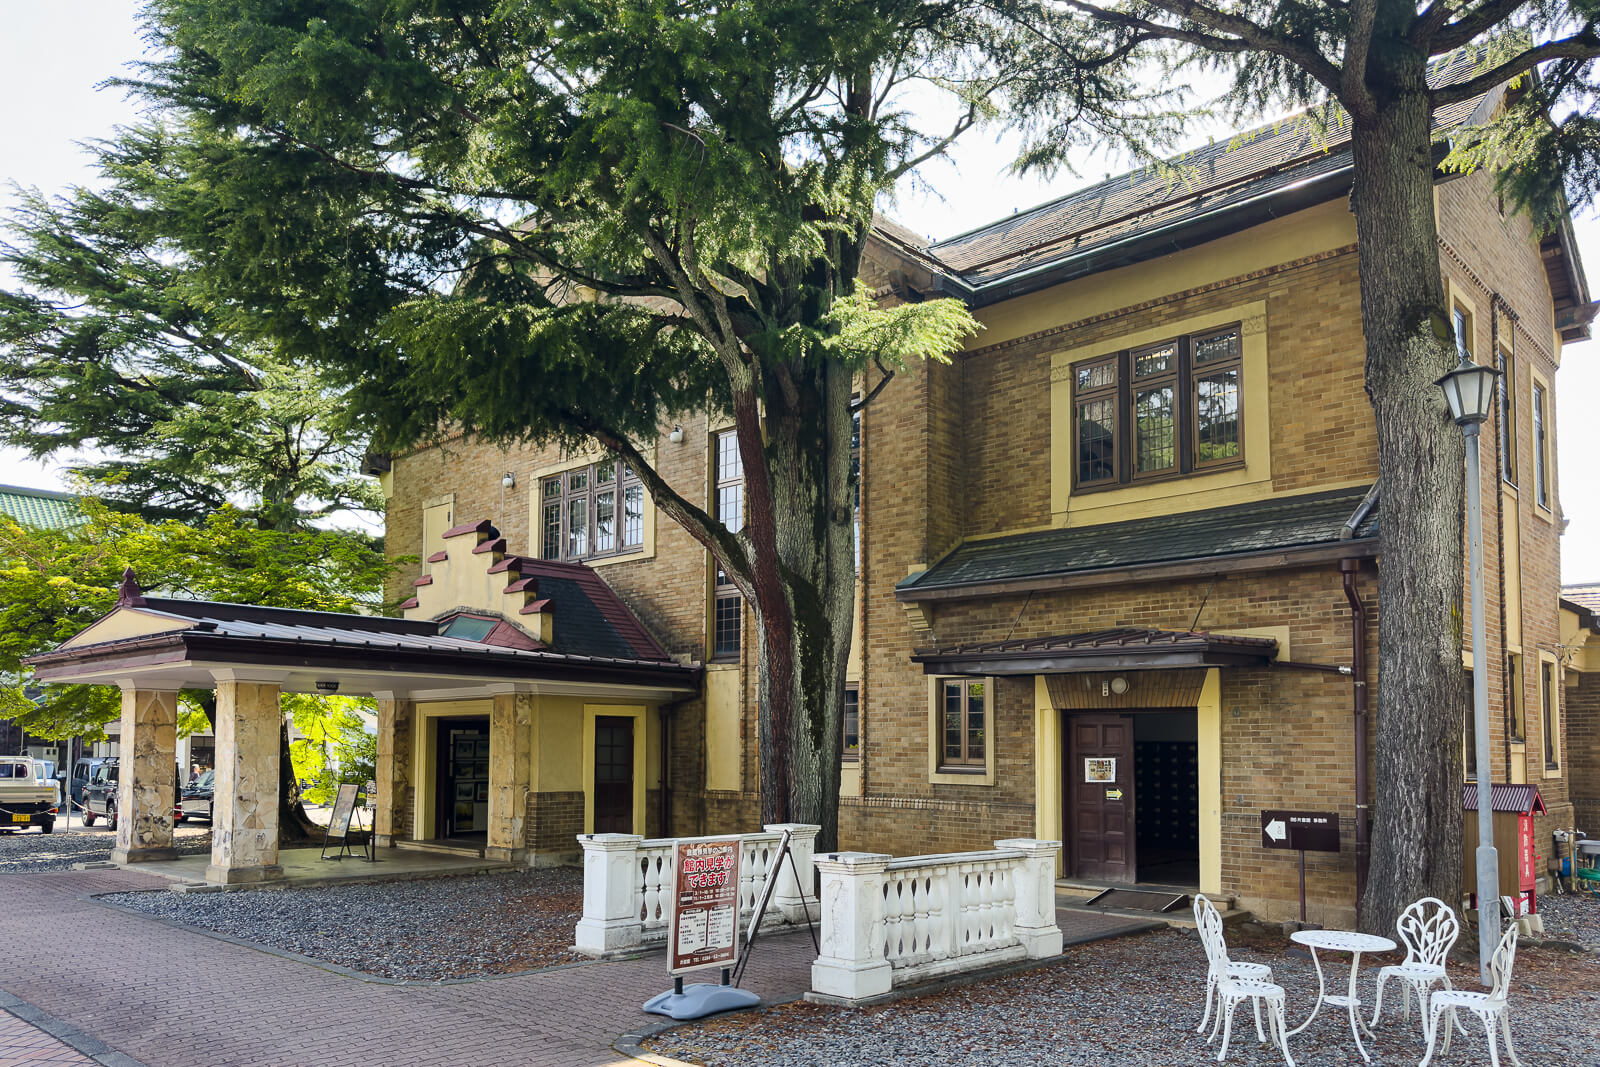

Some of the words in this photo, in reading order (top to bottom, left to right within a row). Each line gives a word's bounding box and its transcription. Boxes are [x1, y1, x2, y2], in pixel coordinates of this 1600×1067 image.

[684, 855, 735, 874] 館内見学が
